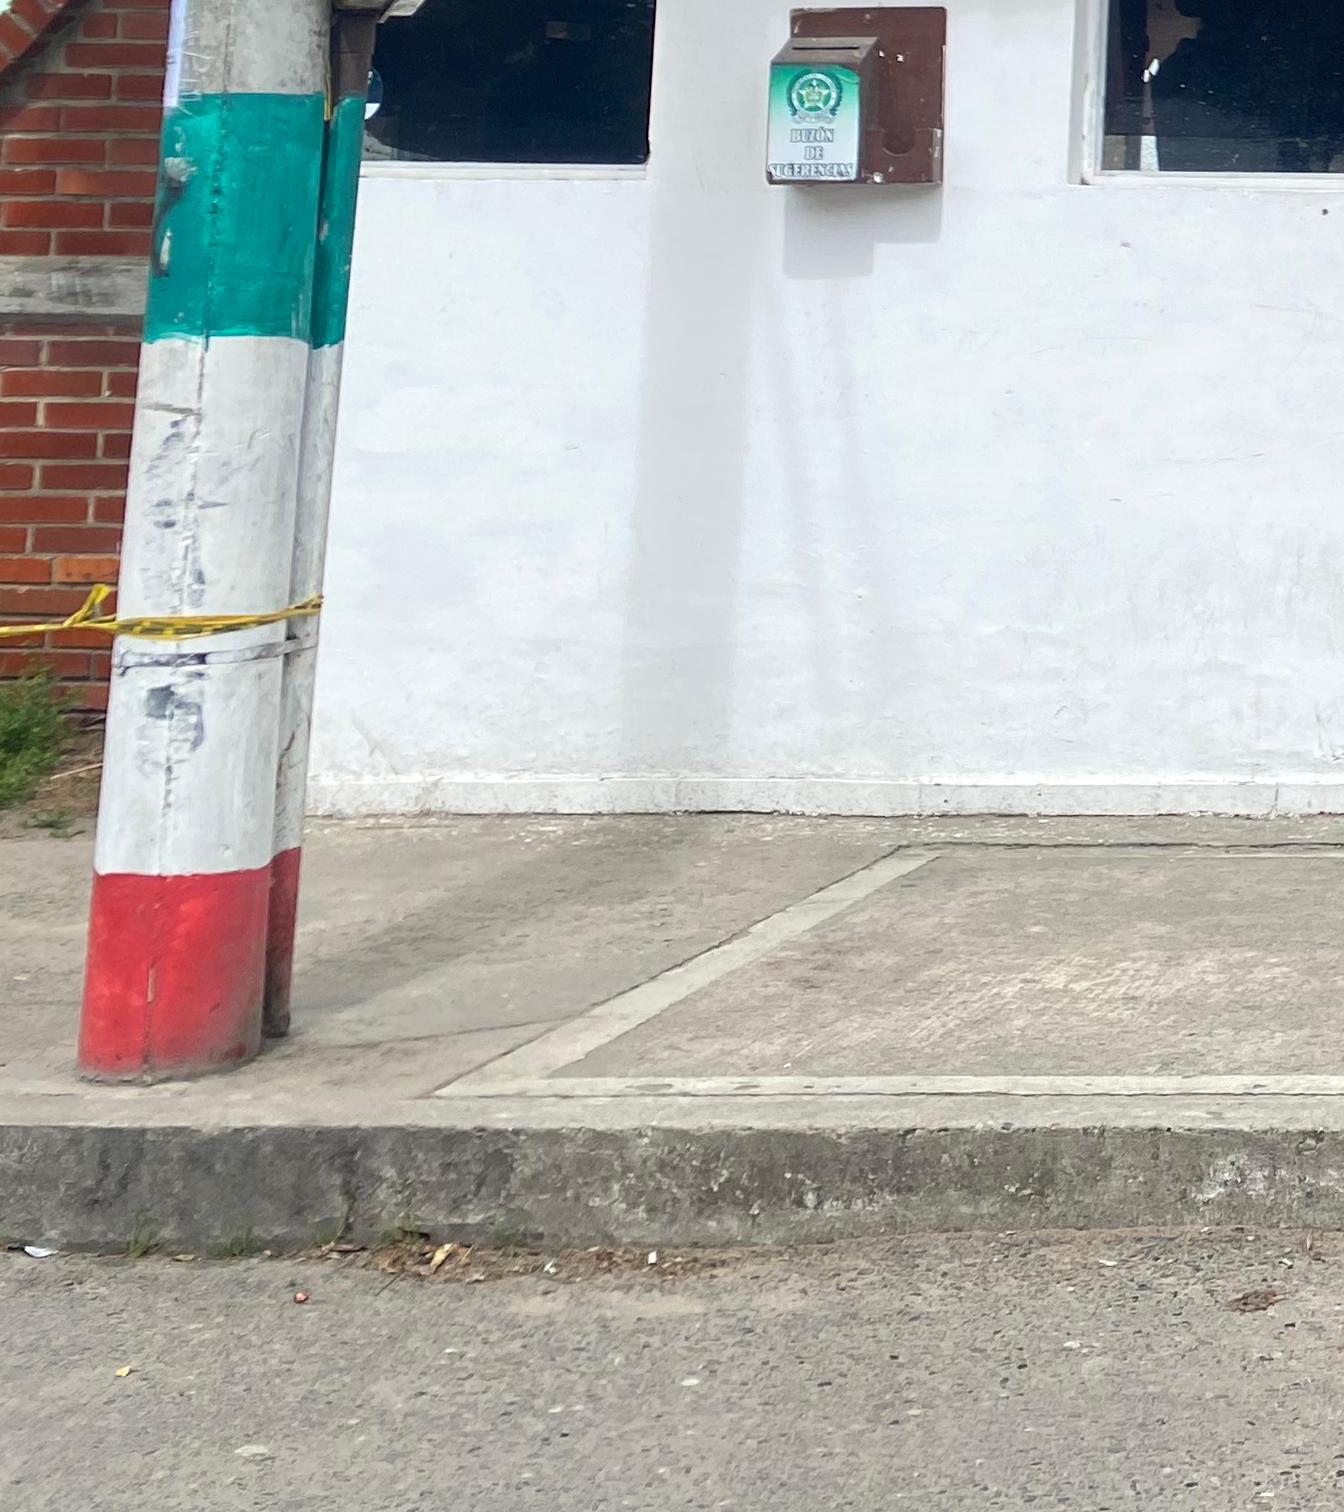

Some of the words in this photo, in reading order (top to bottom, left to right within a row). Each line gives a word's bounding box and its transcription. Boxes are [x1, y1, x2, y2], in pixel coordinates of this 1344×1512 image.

[790, 127, 834, 143] BUZÓN
[804, 146, 823, 160] DE
[769, 163, 853, 177] SUGERENCIAS
